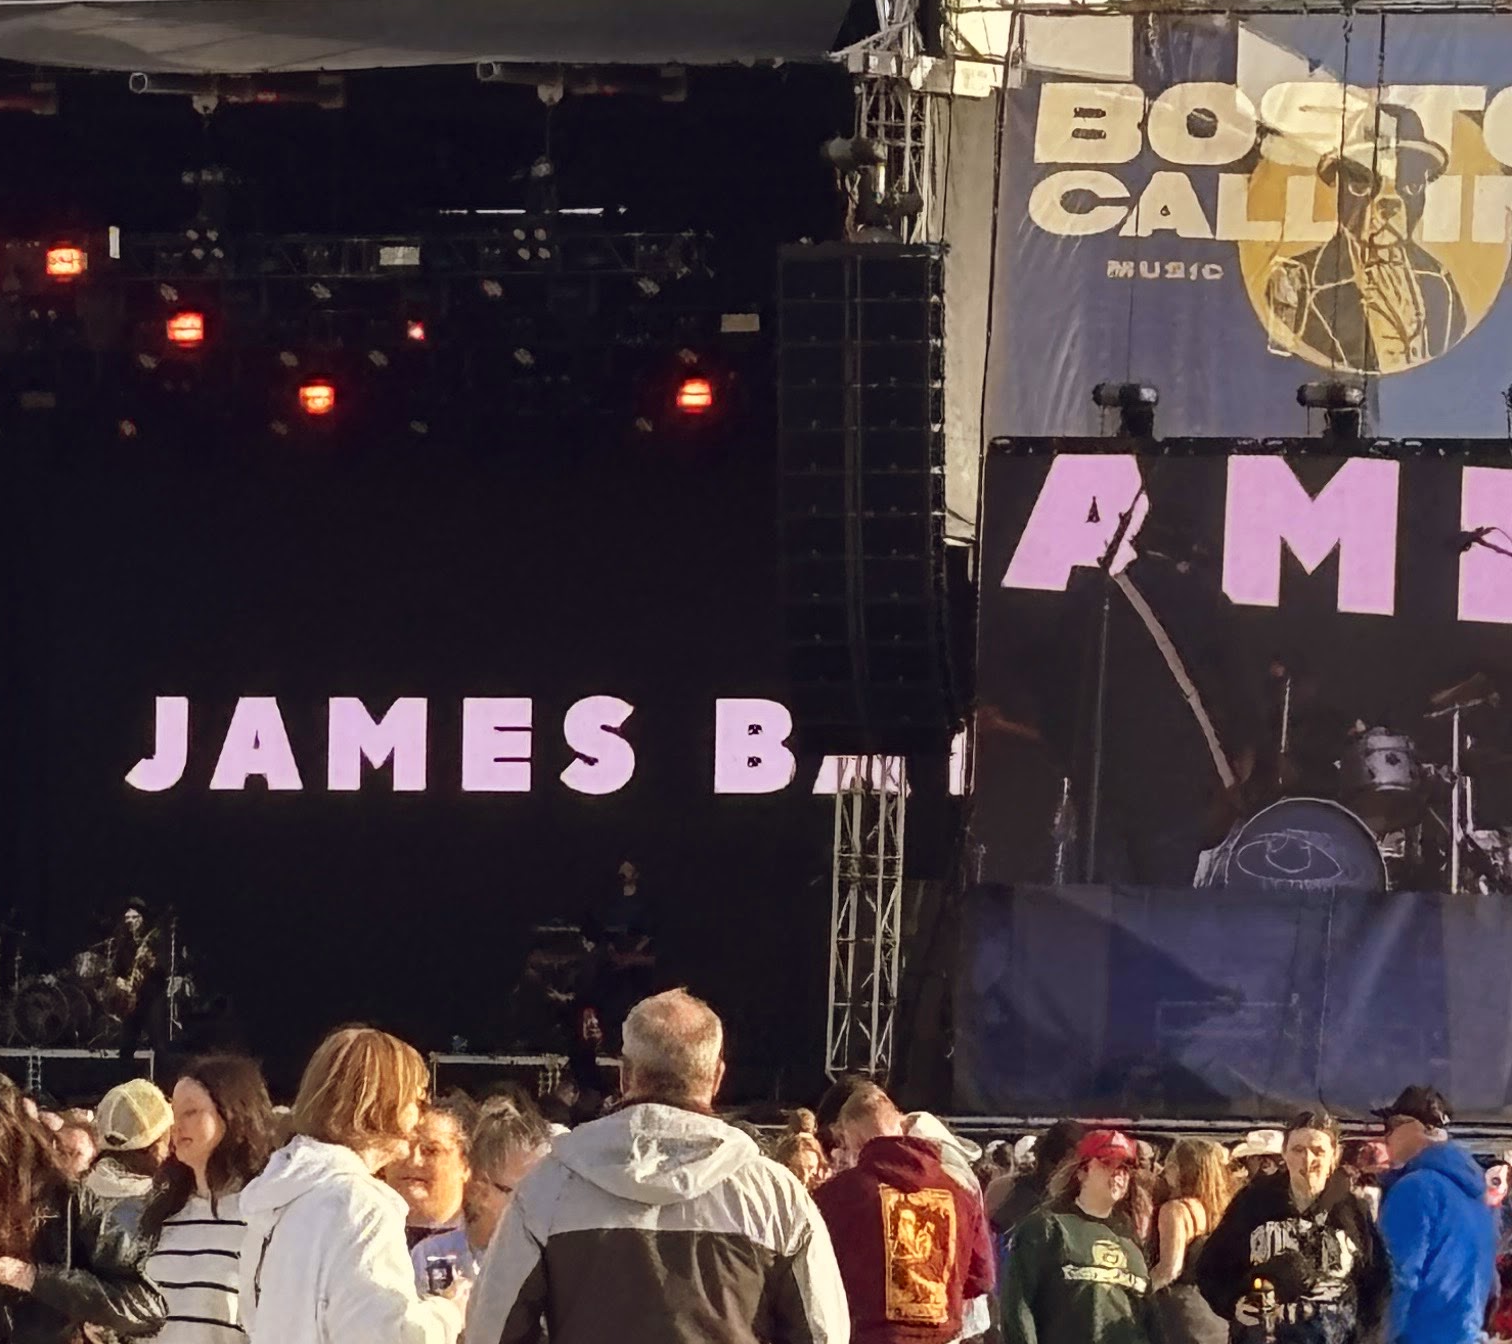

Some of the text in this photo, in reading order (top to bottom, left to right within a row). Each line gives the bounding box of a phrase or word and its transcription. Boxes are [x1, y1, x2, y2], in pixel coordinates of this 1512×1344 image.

[1035, 82, 1512, 164] BOST
[1107, 260, 1224, 280] MUSIC
[124, 694, 637, 795] JAMES
